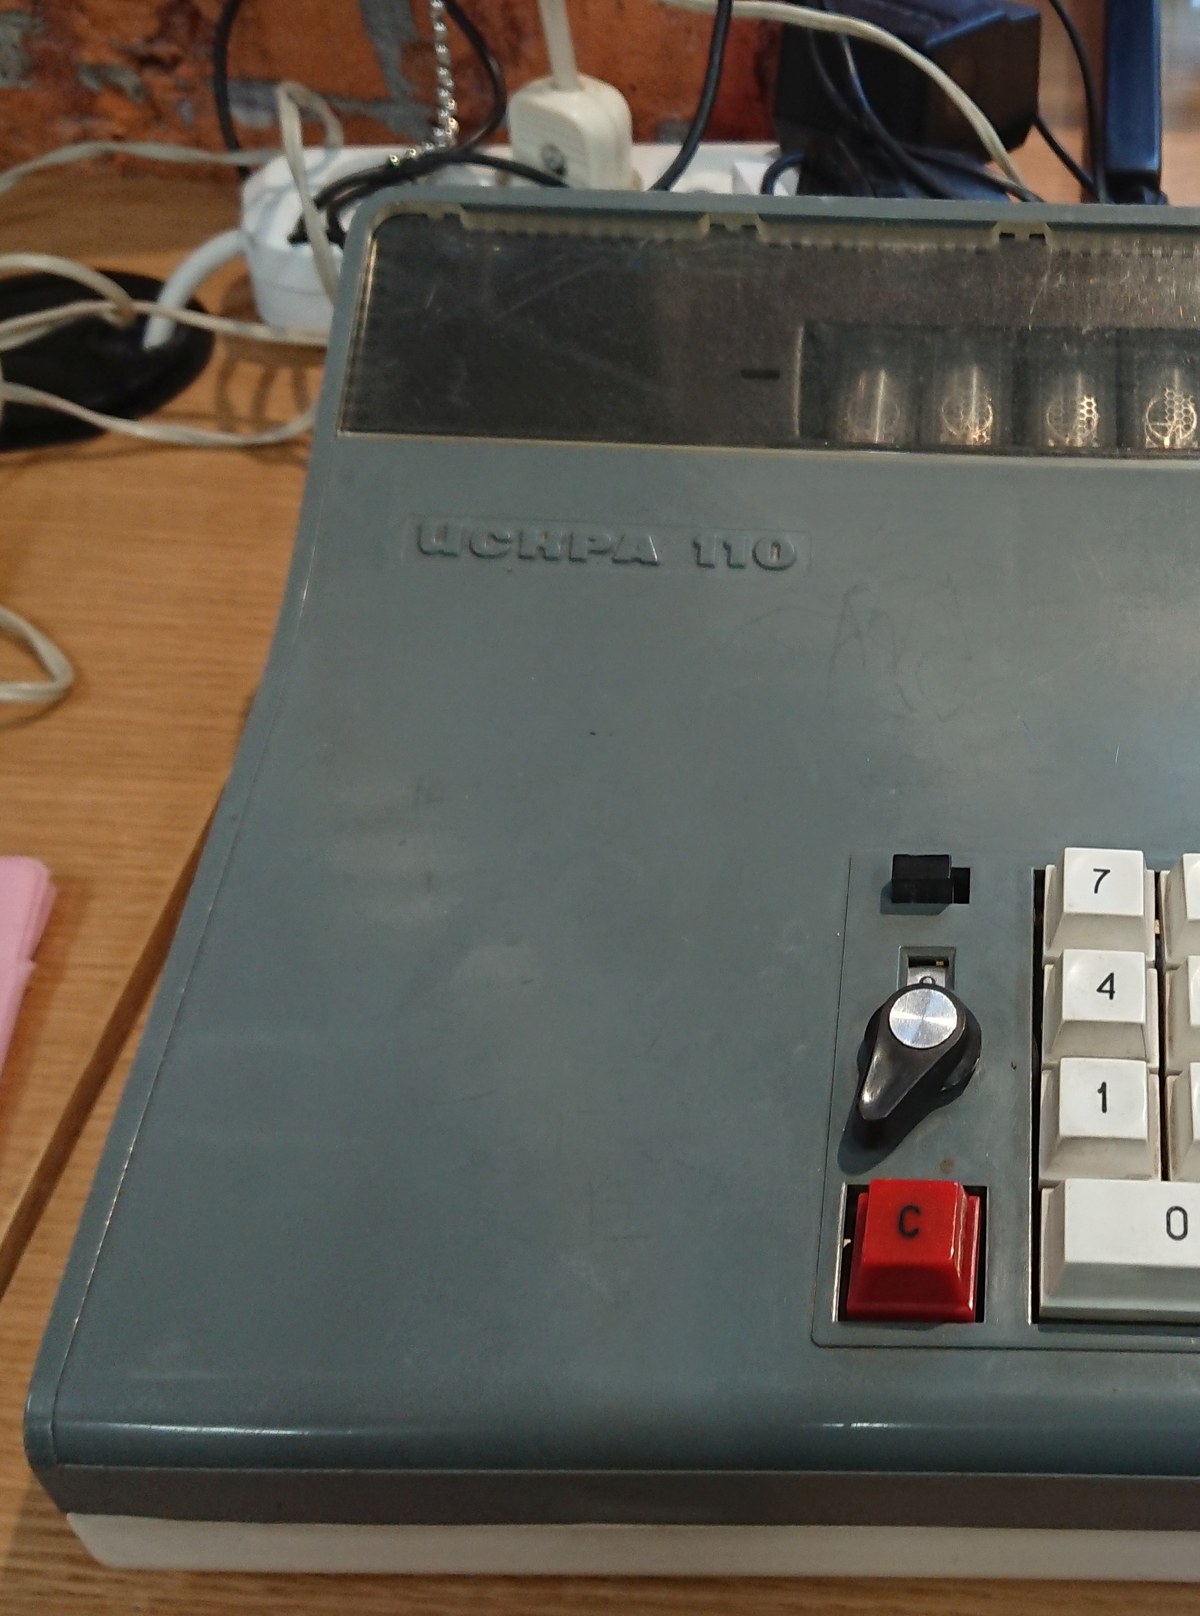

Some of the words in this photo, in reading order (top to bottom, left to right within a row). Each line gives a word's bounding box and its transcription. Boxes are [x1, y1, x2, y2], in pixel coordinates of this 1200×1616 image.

[416, 522, 661, 567] ИСКРА
[692, 532, 798, 572] 110
[1094, 869, 1110, 893] 7
[1097, 973, 1115, 1000] 4
[1098, 1082, 1107, 1113] 1
[1166, 1206, 1188, 1240] 0
